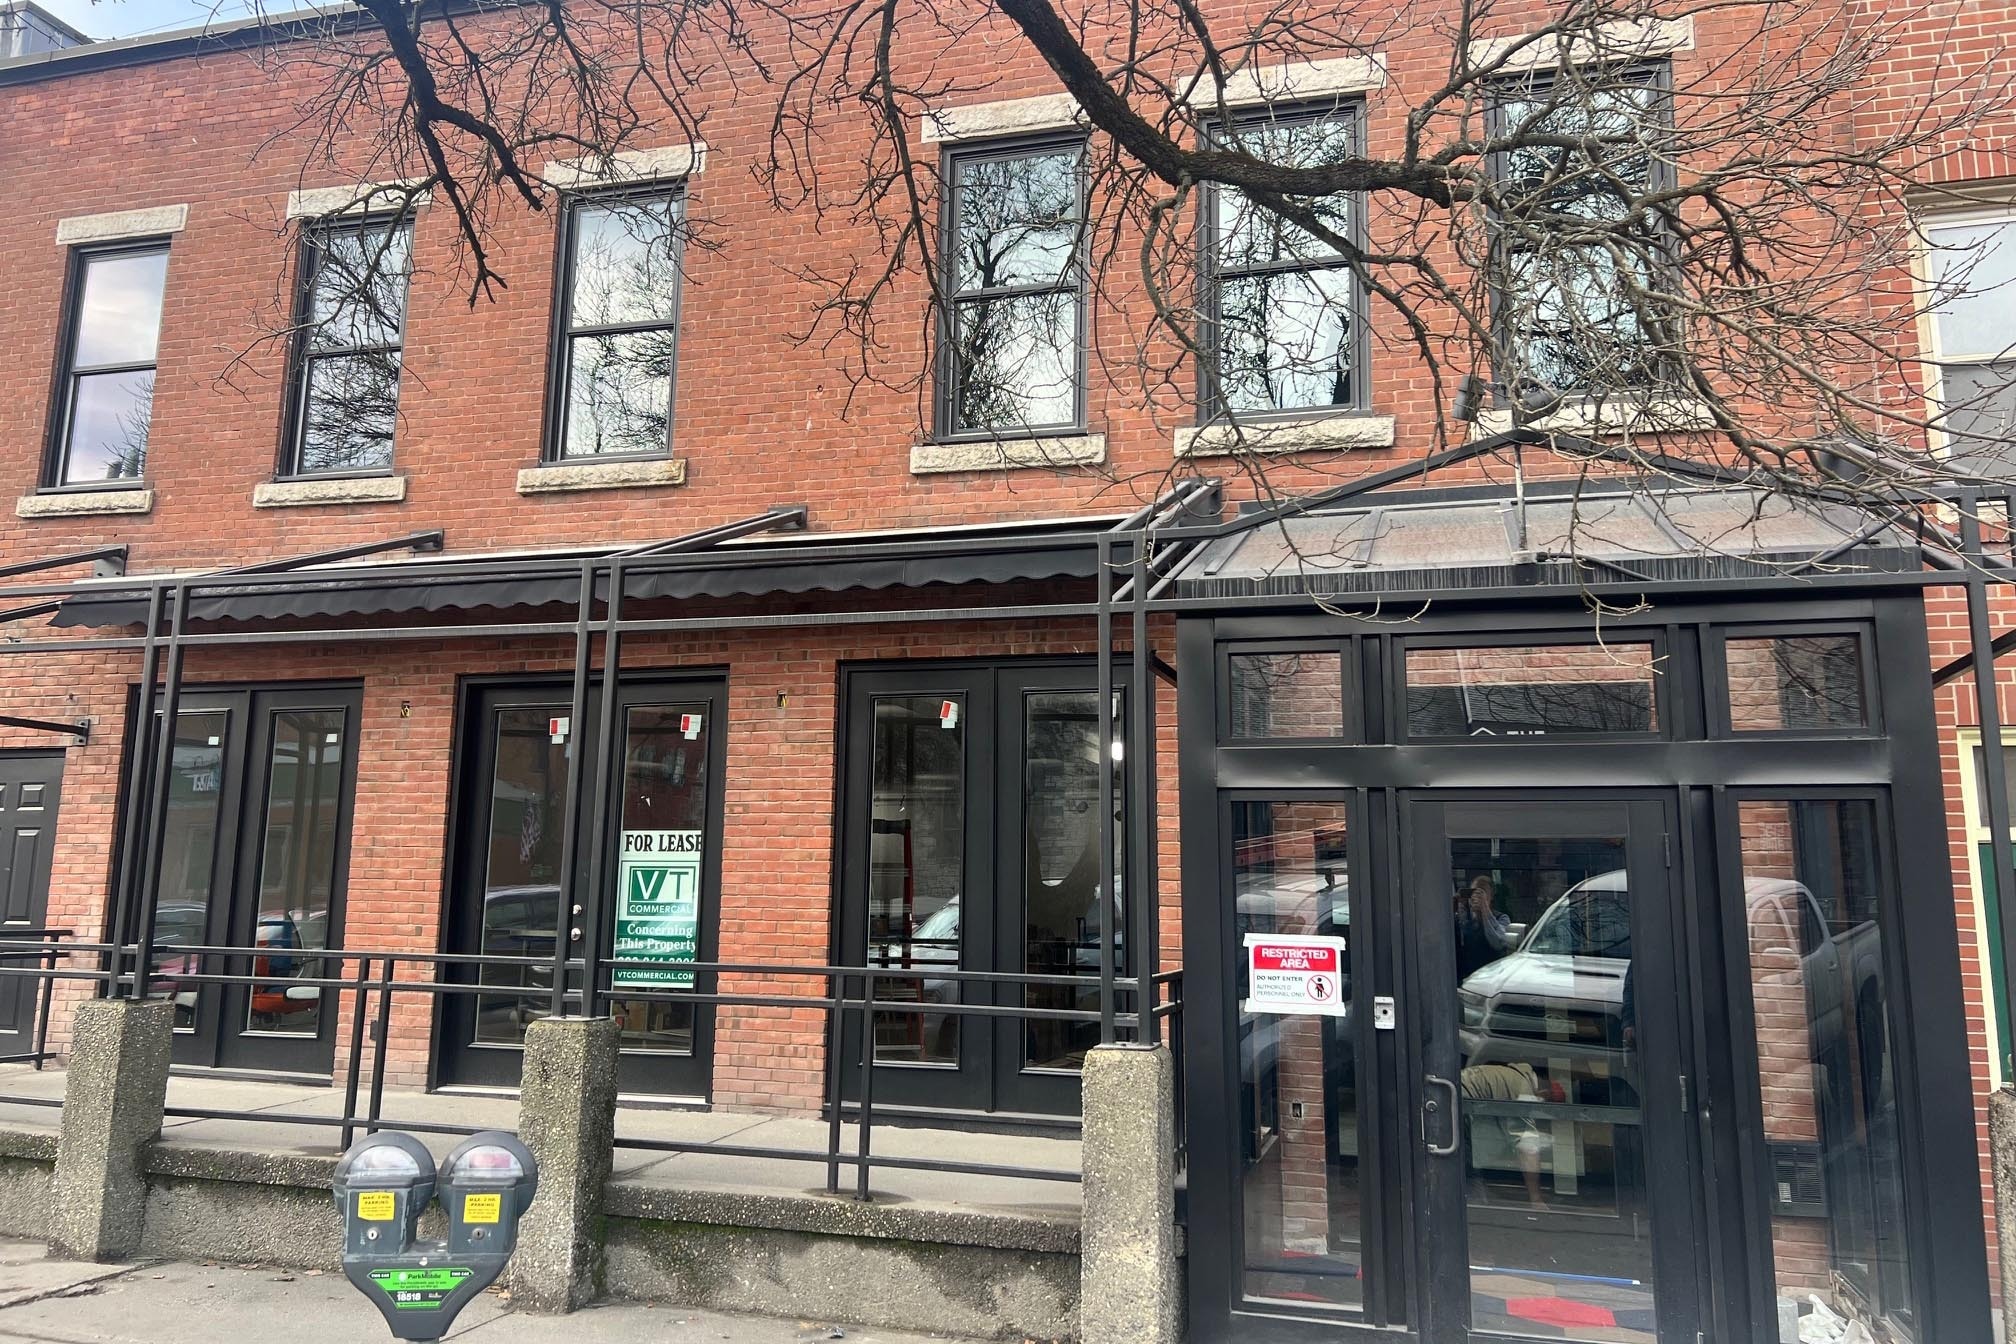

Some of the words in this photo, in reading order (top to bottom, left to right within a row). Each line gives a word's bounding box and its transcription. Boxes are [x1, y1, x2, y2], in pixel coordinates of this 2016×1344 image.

[624, 834, 653, 852] FOR
[636, 870, 689, 900] VT
[629, 904, 692, 914] COMMERCIAL
[627, 923, 694, 938] Concerning
[620, 938, 644, 949] This
[646, 938, 696, 953] Property
[1261, 947, 1328, 960] RESTRICTED
[1280, 958, 1310, 969] AREA
[617, 971, 695, 980] VTCOMMERCIAL.COM
